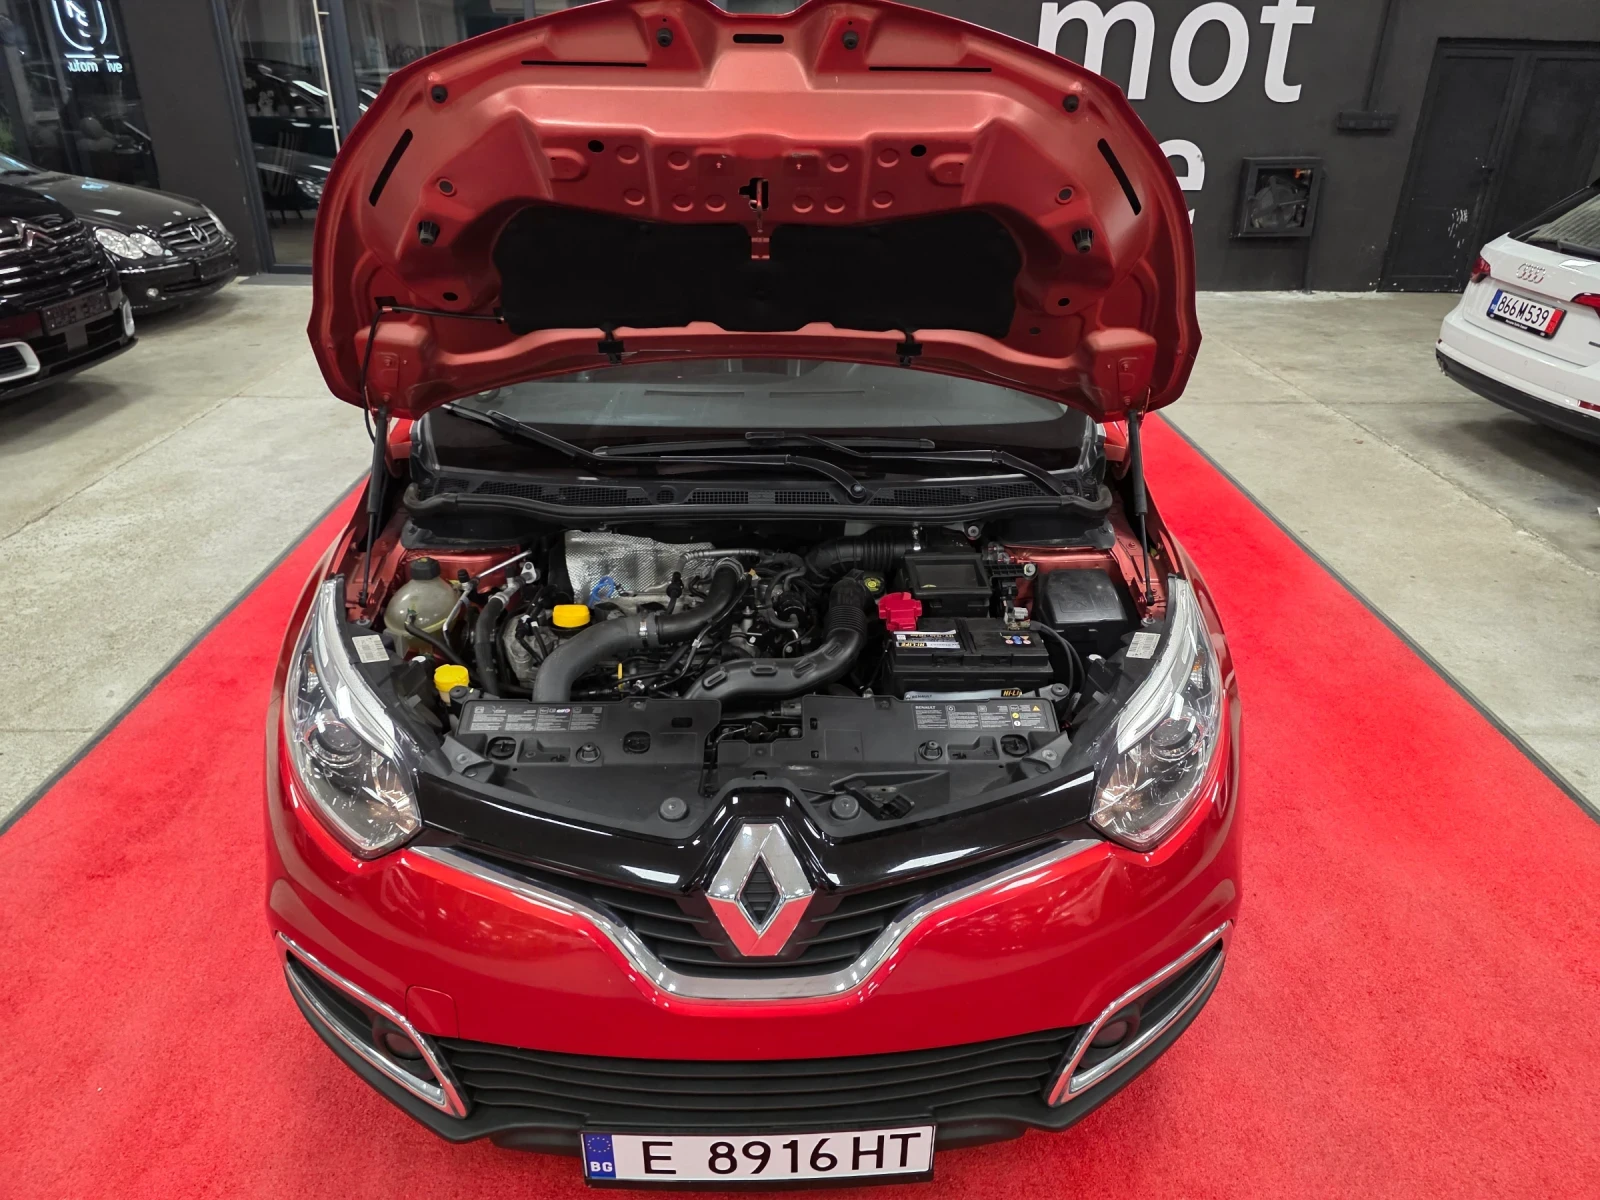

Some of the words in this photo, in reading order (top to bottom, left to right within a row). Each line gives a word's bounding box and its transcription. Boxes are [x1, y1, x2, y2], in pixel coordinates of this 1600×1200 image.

[1038, 0, 1315, 103] mot
[590, 1161, 613, 1172] BG
[642, 1141, 677, 1174] E
